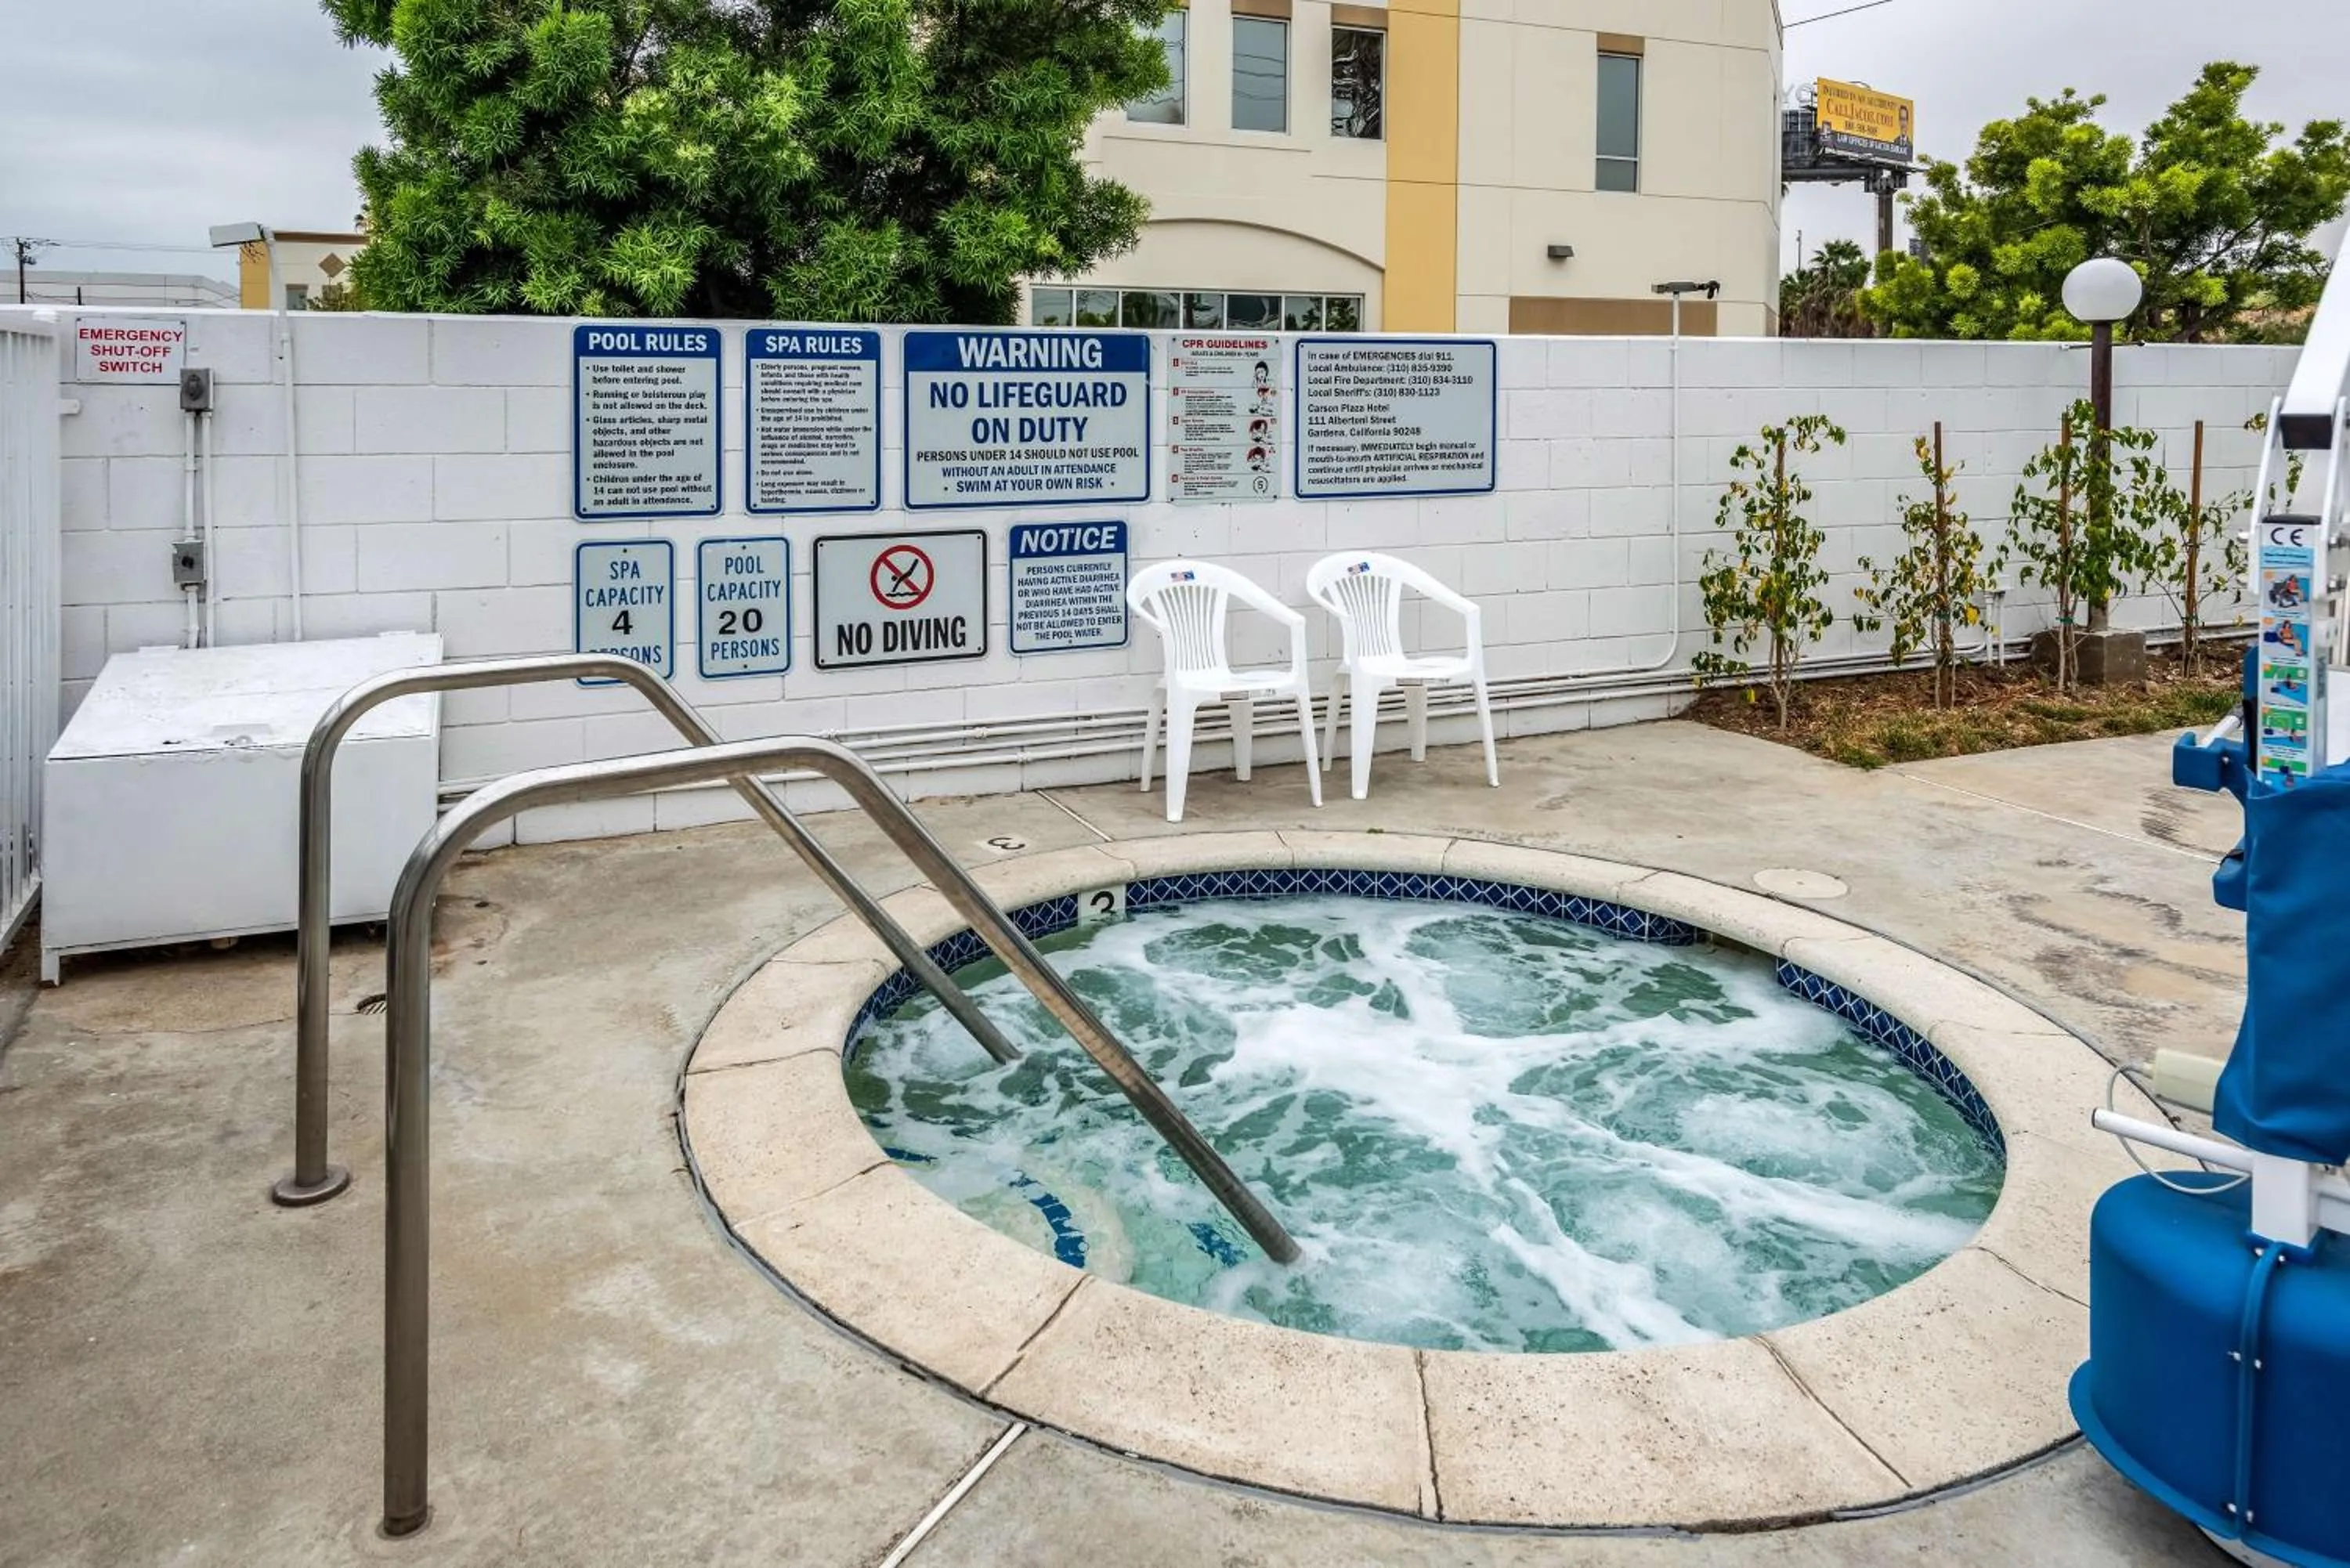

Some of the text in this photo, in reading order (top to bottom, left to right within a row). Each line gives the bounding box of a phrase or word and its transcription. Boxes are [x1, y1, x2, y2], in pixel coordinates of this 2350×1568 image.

[79, 328, 183, 341] EMERGENCY
[589, 333, 707, 351] POOL RULES
[91, 345, 171, 357] SHUT-OFF
[765, 335, 862, 354] SPA RULES
[958, 337, 1103, 368] WARNING
[1206, 340, 1267, 349] GUIDELINES
[1352, 351, 1415, 360] EMERGENCIES
[99, 362, 162, 373] SWITCH
[591, 375, 620, 384] before
[1333, 375, 1350, 384] Fire
[930, 381, 1127, 409] NO LIFEGUARD
[1340, 403, 1365, 412] Plaza
[1366, 403, 1390, 412] Hotel
[1308, 416, 1325, 425] 111
[971, 417, 1088, 444] ON DUTY
[916, 447, 1137, 461] PERSONS UNDER 14 SHOULD NOT USE POOL
[942, 463, 1115, 476] WITHOUT AN ADULT IN ATTENDANCE
[956, 477, 1102, 492] SWIM AT YOUR OWN RISK
[1020, 526, 1117, 553] NOTICE
[609, 561, 640, 580] SPA
[725, 555, 764, 575] POOL
[585, 586, 664, 607] CAPACITY
[707, 580, 781, 602] CAPACITY
[612, 610, 633, 634] 4
[719, 608, 763, 634] 20
[837, 616, 966, 656] NO DIVING
[589, 645, 662, 664] SONS
[711, 638, 779, 659] PERSONS
